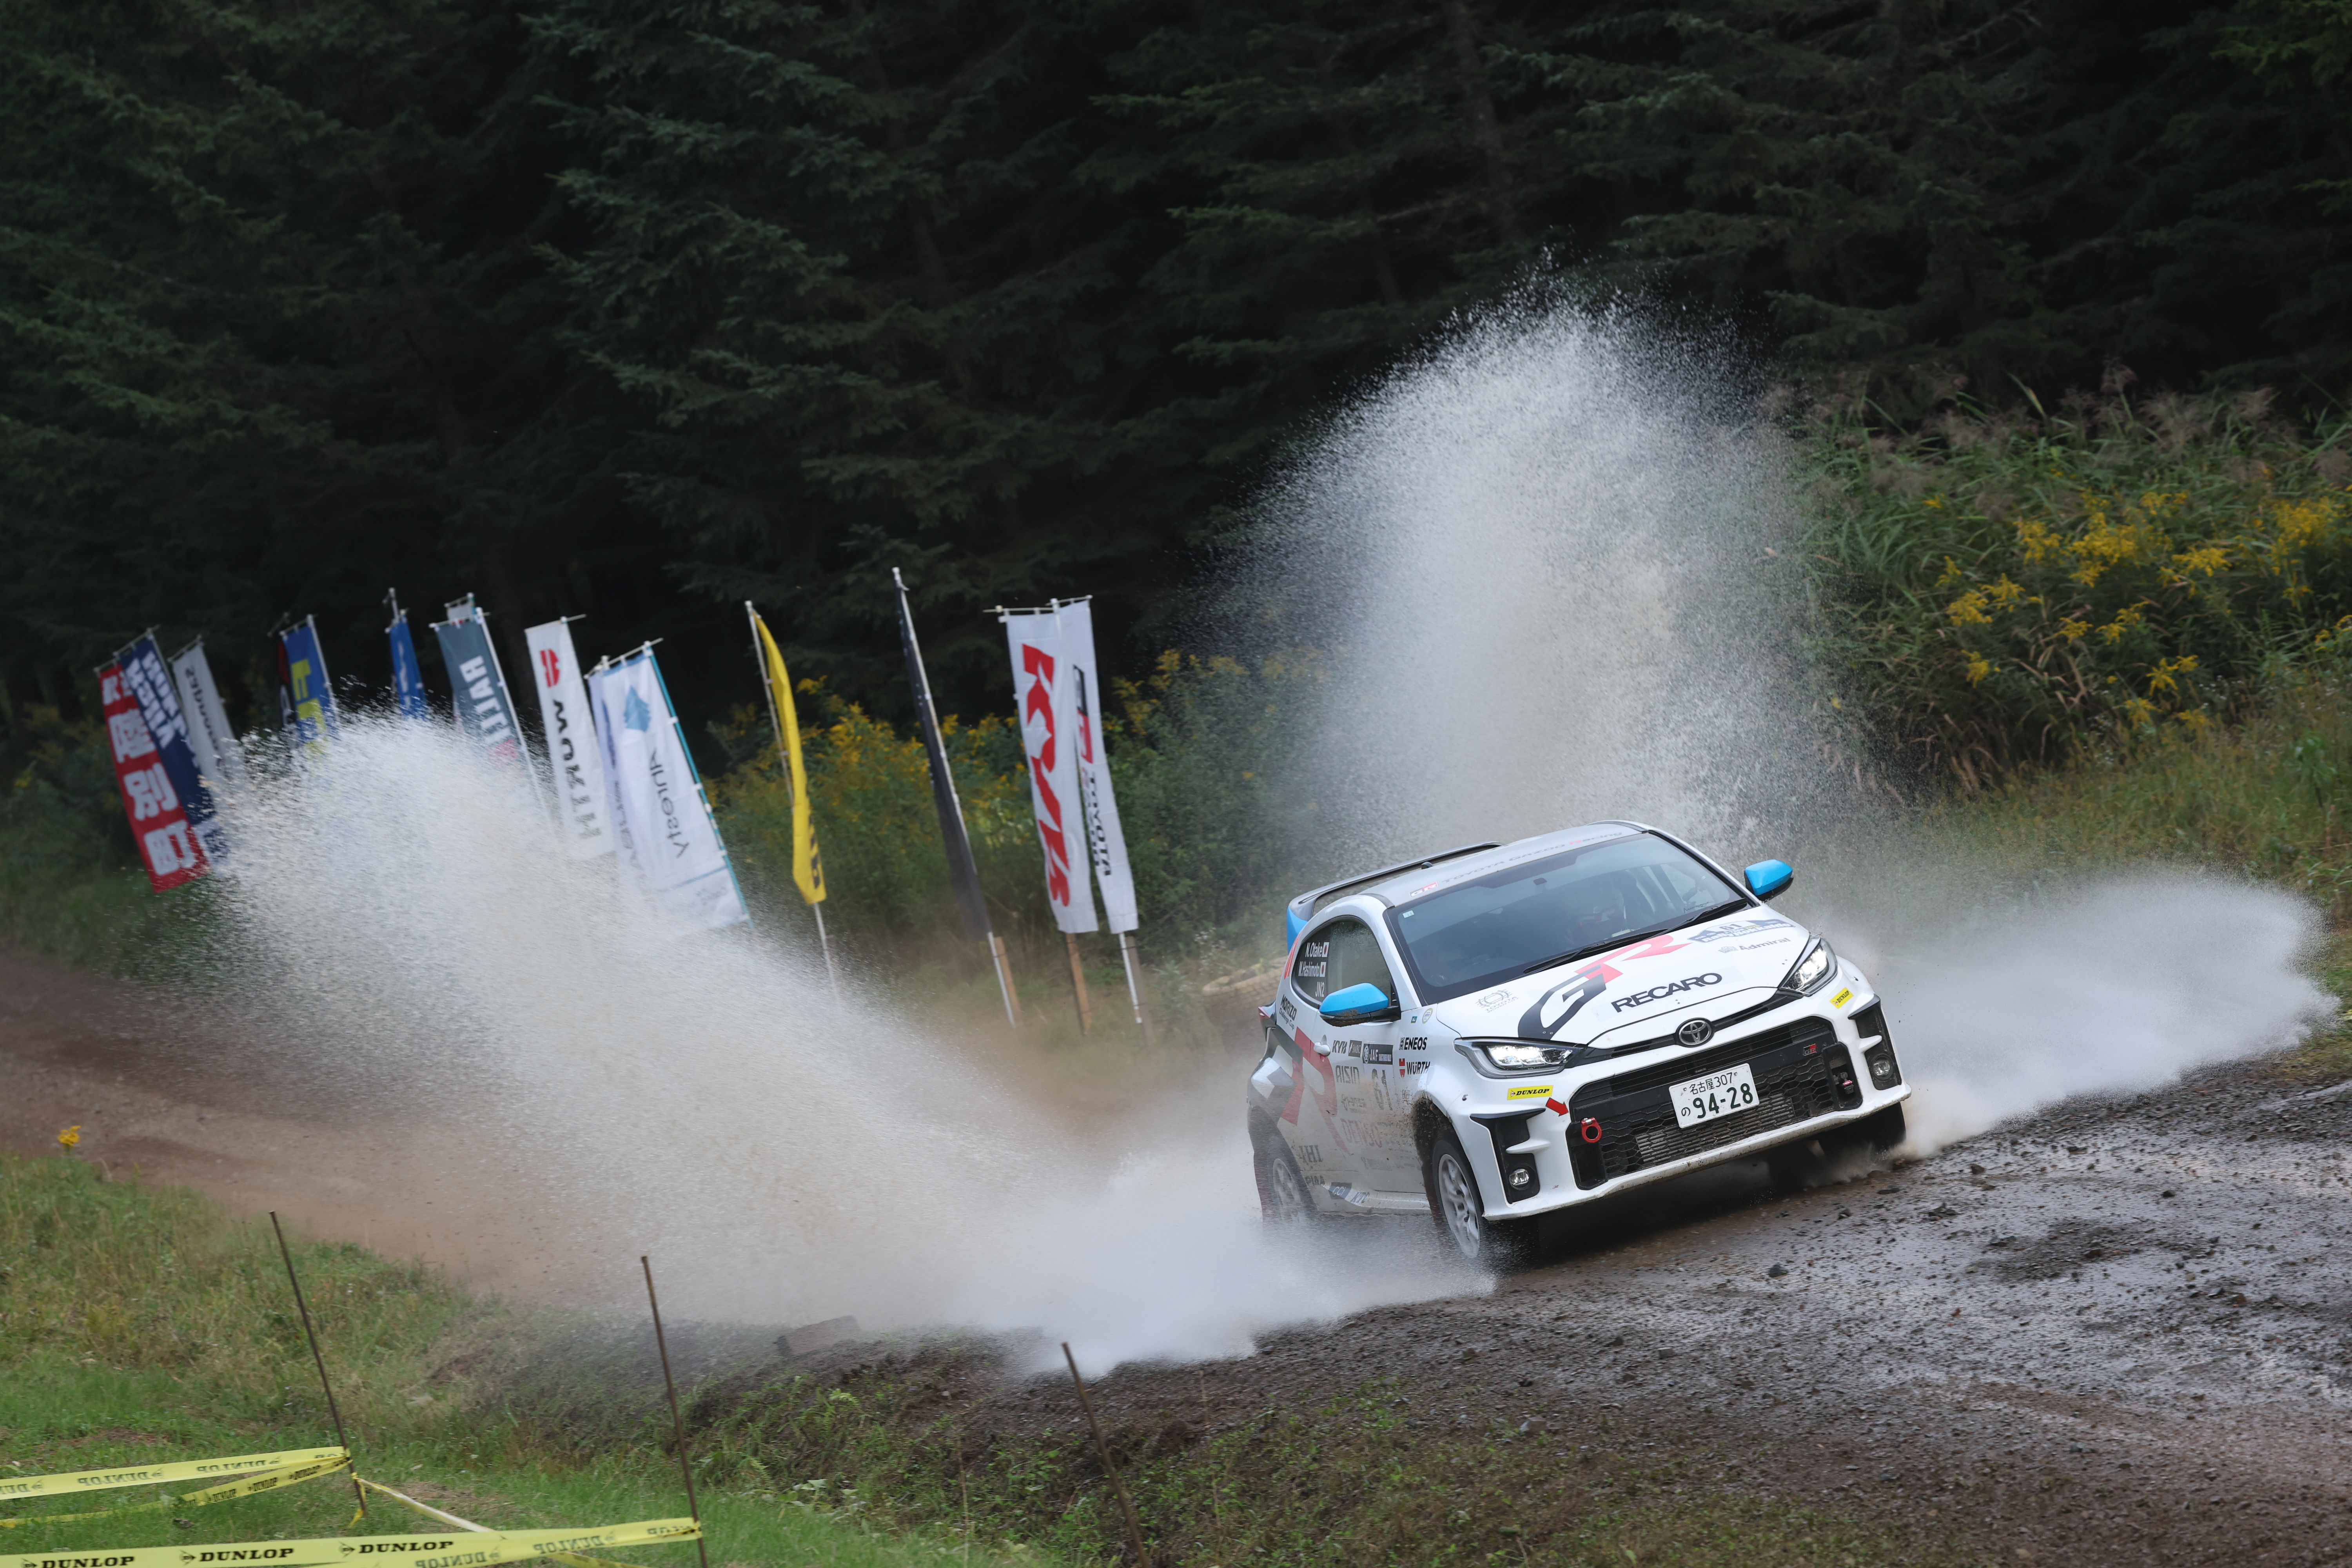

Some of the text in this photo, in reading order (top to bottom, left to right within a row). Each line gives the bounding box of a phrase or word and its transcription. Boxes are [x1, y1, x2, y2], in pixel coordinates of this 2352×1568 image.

[1022, 643, 1070, 907] KYB
[109, 708, 195, 876] 陸別町
[1441, 861, 1504, 883] TOYOTA
[1508, 844, 1566, 861] GAZOO
[1569, 832, 1622, 845] Racing
[1701, 933, 1735, 942] Rally
[1733, 923, 1791, 936] Hokkaido
[1305, 942, 1323, 957] N.Otake
[1739, 938, 1791, 950] Admiral
[1298, 961, 1320, 977] M.Hashimoto
[1315, 982, 1325, 997] JN2
[1611, 973, 1722, 1013] RECARO
[1837, 990, 1850, 1003] DUNLOP
[1280, 994, 1297, 1021] MORIZO
[1485, 996, 1518, 1011] TOYOTA
[1487, 1003, 1507, 1013] WOVEN
[1279, 1007, 1289, 1024] Challenge
[1332, 1040, 1347, 1054] KYB
[1352, 1044, 1361, 1054] SMBC
[1404, 1037, 1428, 1051] ENEOS
[1369, 1049, 1379, 1062] JAF
[1372, 1069, 1393, 1111] 61
[1693, 1083, 1753, 1118] 94-28
[1681, 1107, 1691, 1116] の
[1299, 1145, 1323, 1163] IHI
[199, 1548, 294, 1562] DUNLOP
[359, 1541, 454, 1554] DUNLOP
[41, 1556, 135, 1568] DUNLOP
